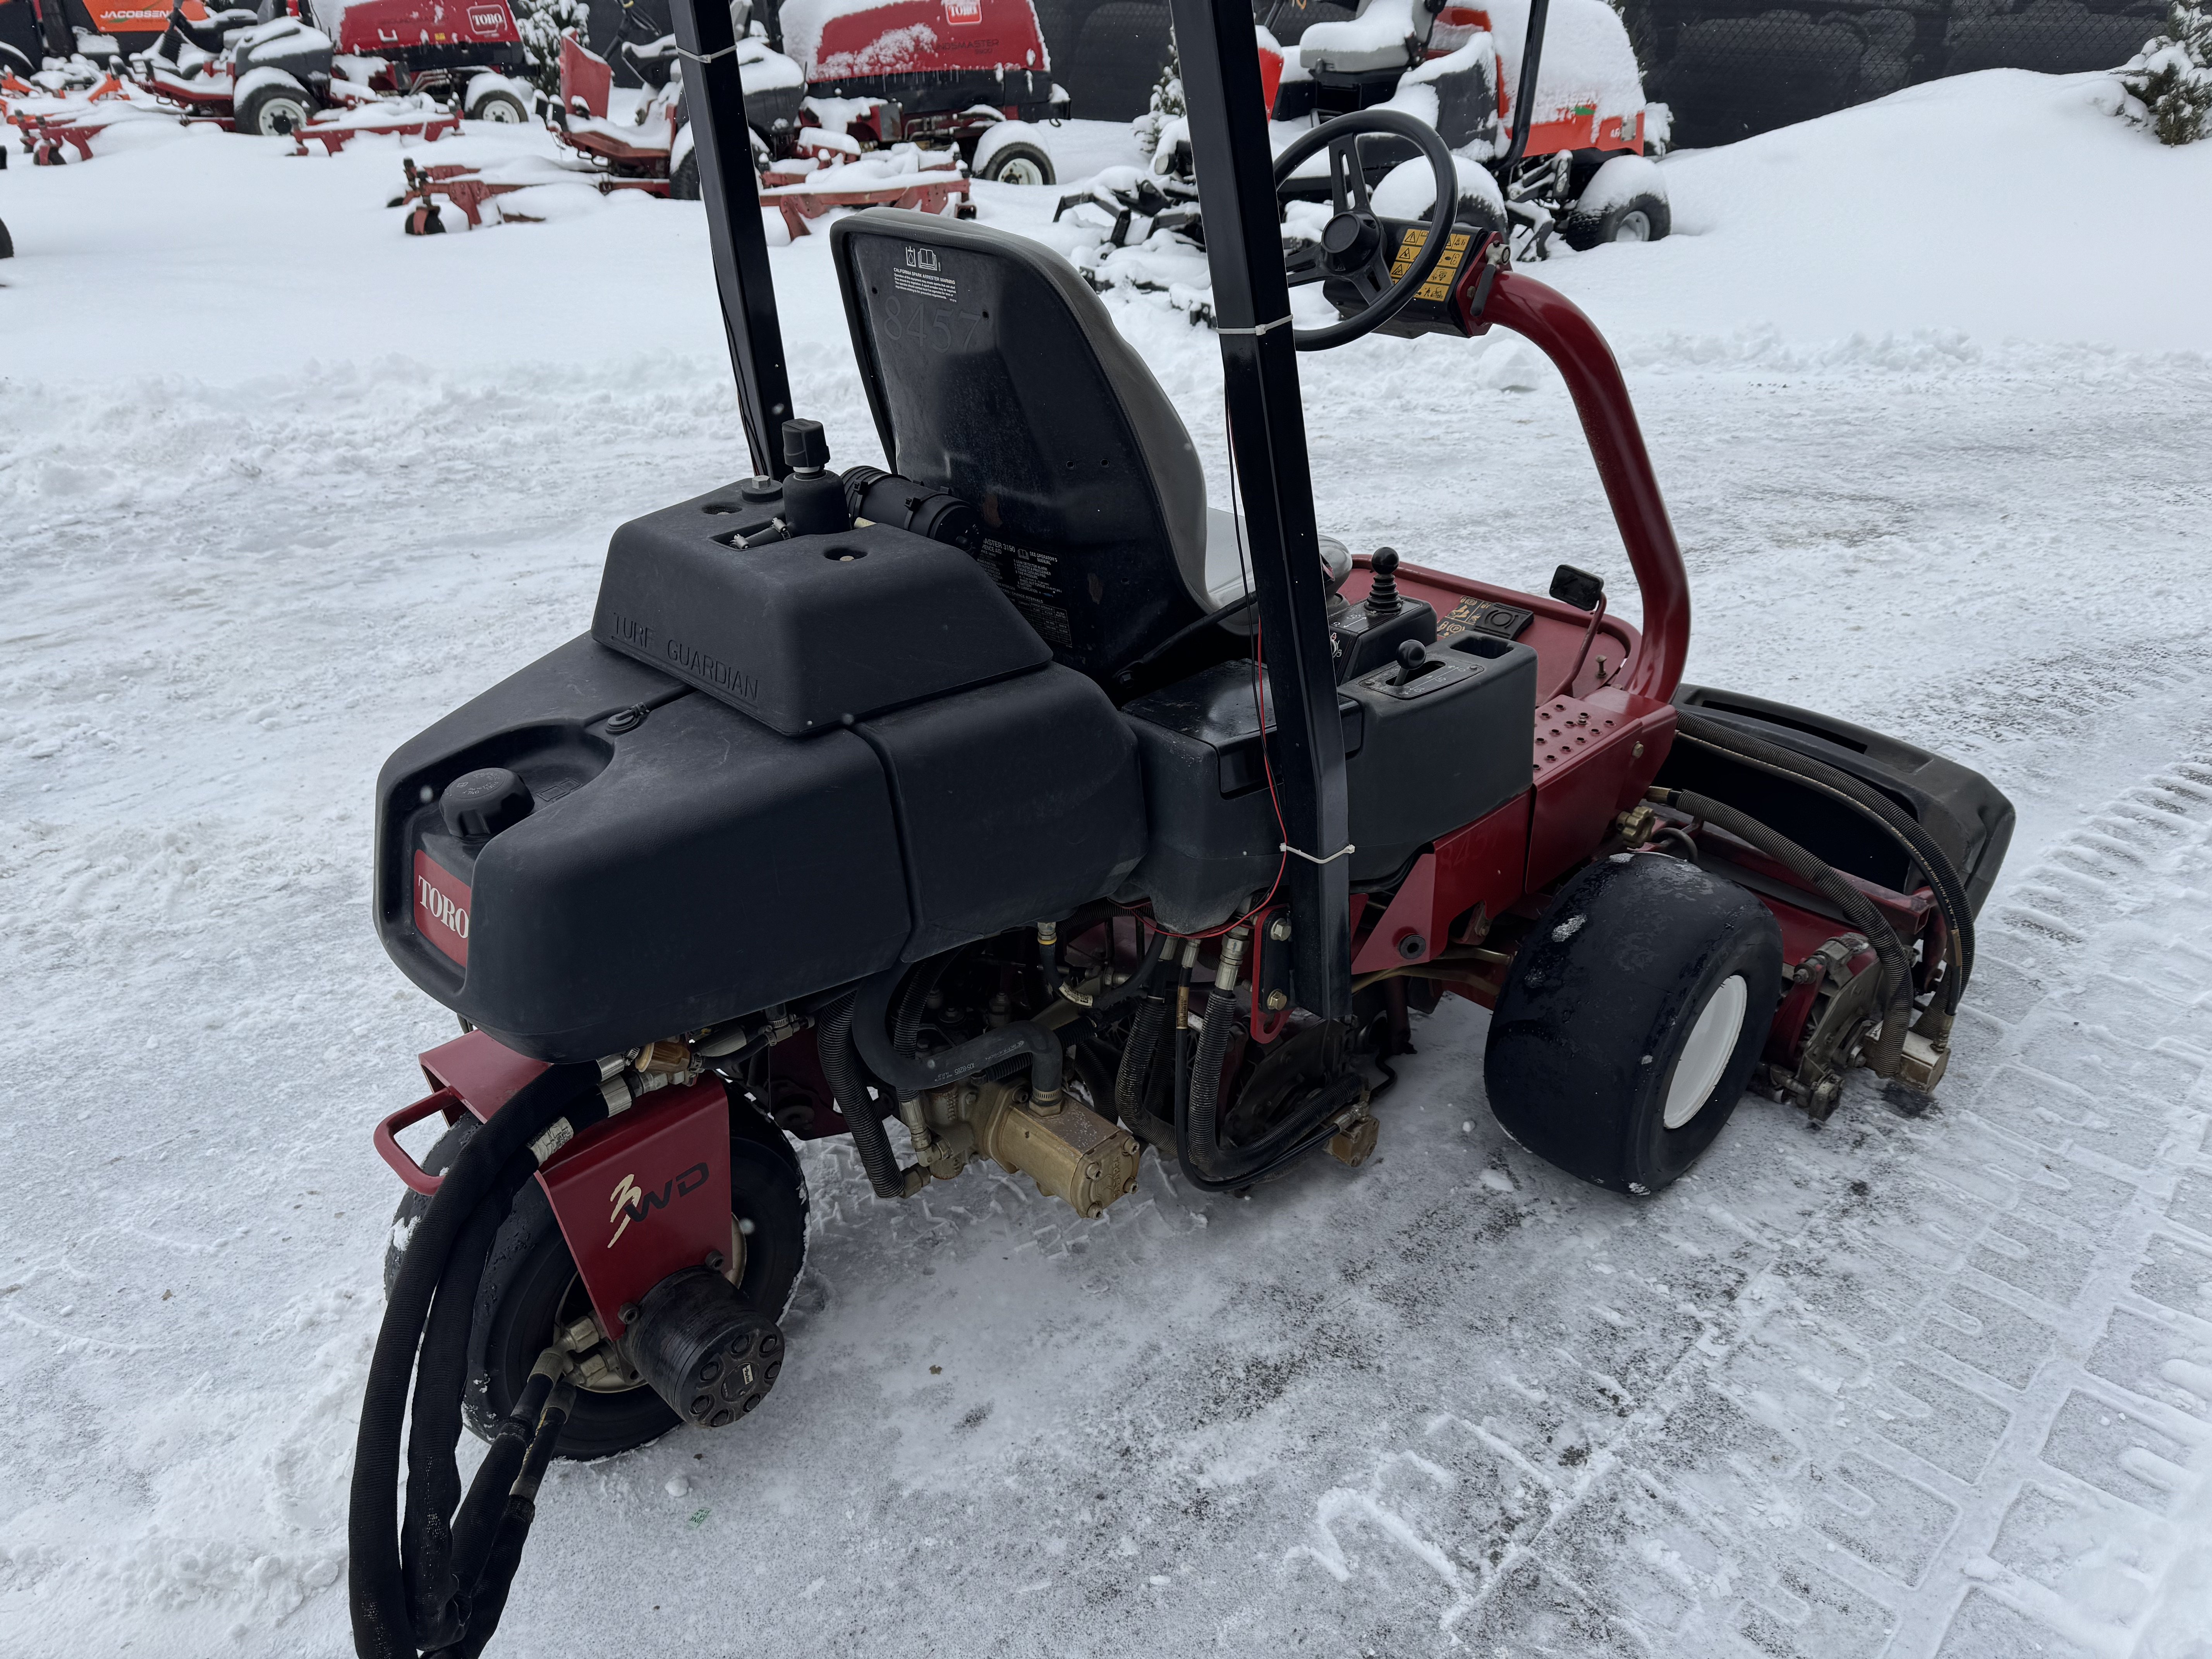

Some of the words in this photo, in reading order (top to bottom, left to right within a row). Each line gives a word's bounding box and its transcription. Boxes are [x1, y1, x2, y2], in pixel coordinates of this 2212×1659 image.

[100, 10, 171, 19] JACOBSEN
[472, 13, 504, 26] TORO
[893, 267, 912, 276] CALIFORNIA
[1003, 543, 1015, 553] 3150
[613, 612, 656, 649] TURF
[667, 639, 758, 701] GUARDIAN
[418, 874, 469, 939] TORO
[954, 1062, 975, 1075] 105-8265
[607, 1162, 710, 1249] 3WD
